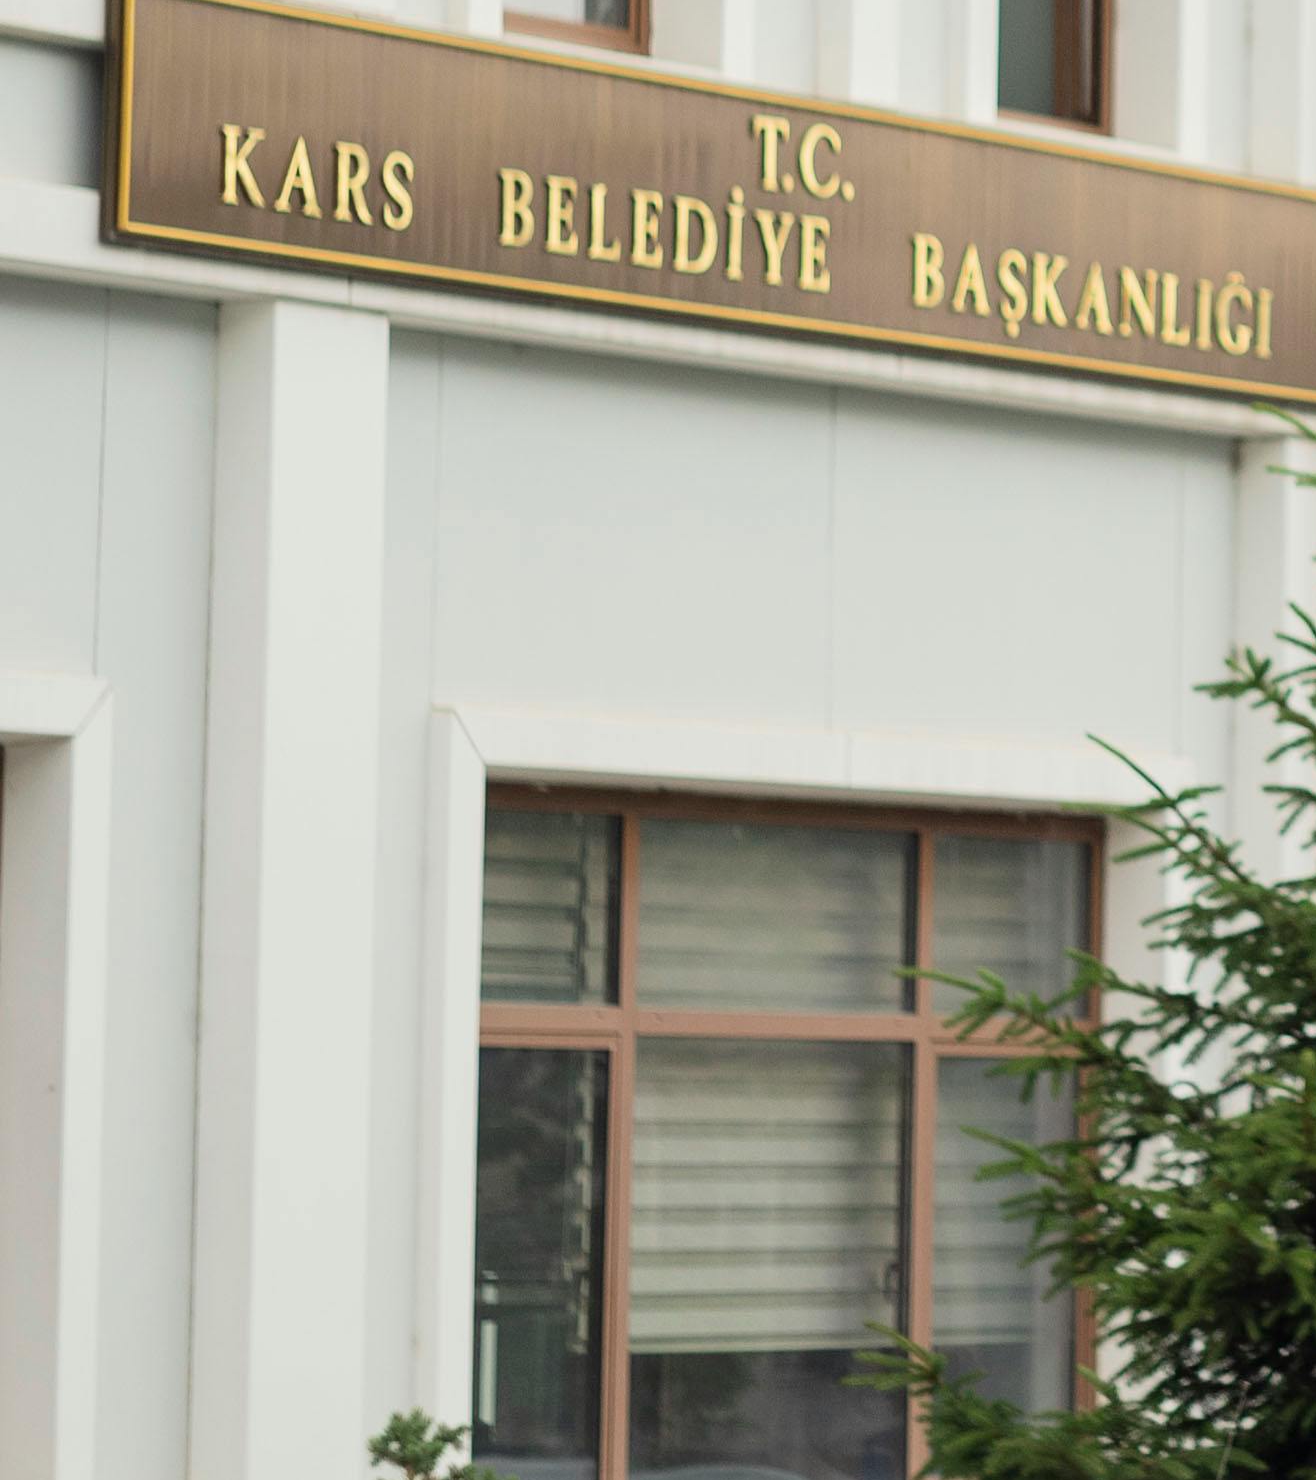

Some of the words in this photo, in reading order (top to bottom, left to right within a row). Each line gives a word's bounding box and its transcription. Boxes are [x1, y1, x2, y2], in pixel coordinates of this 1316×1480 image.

[752, 113, 856, 203] T.C.
[220, 122, 415, 232] KARS
[498, 167, 833, 295] BELEDİYE
[912, 231, 1275, 360] BAŞKANLIĞI
